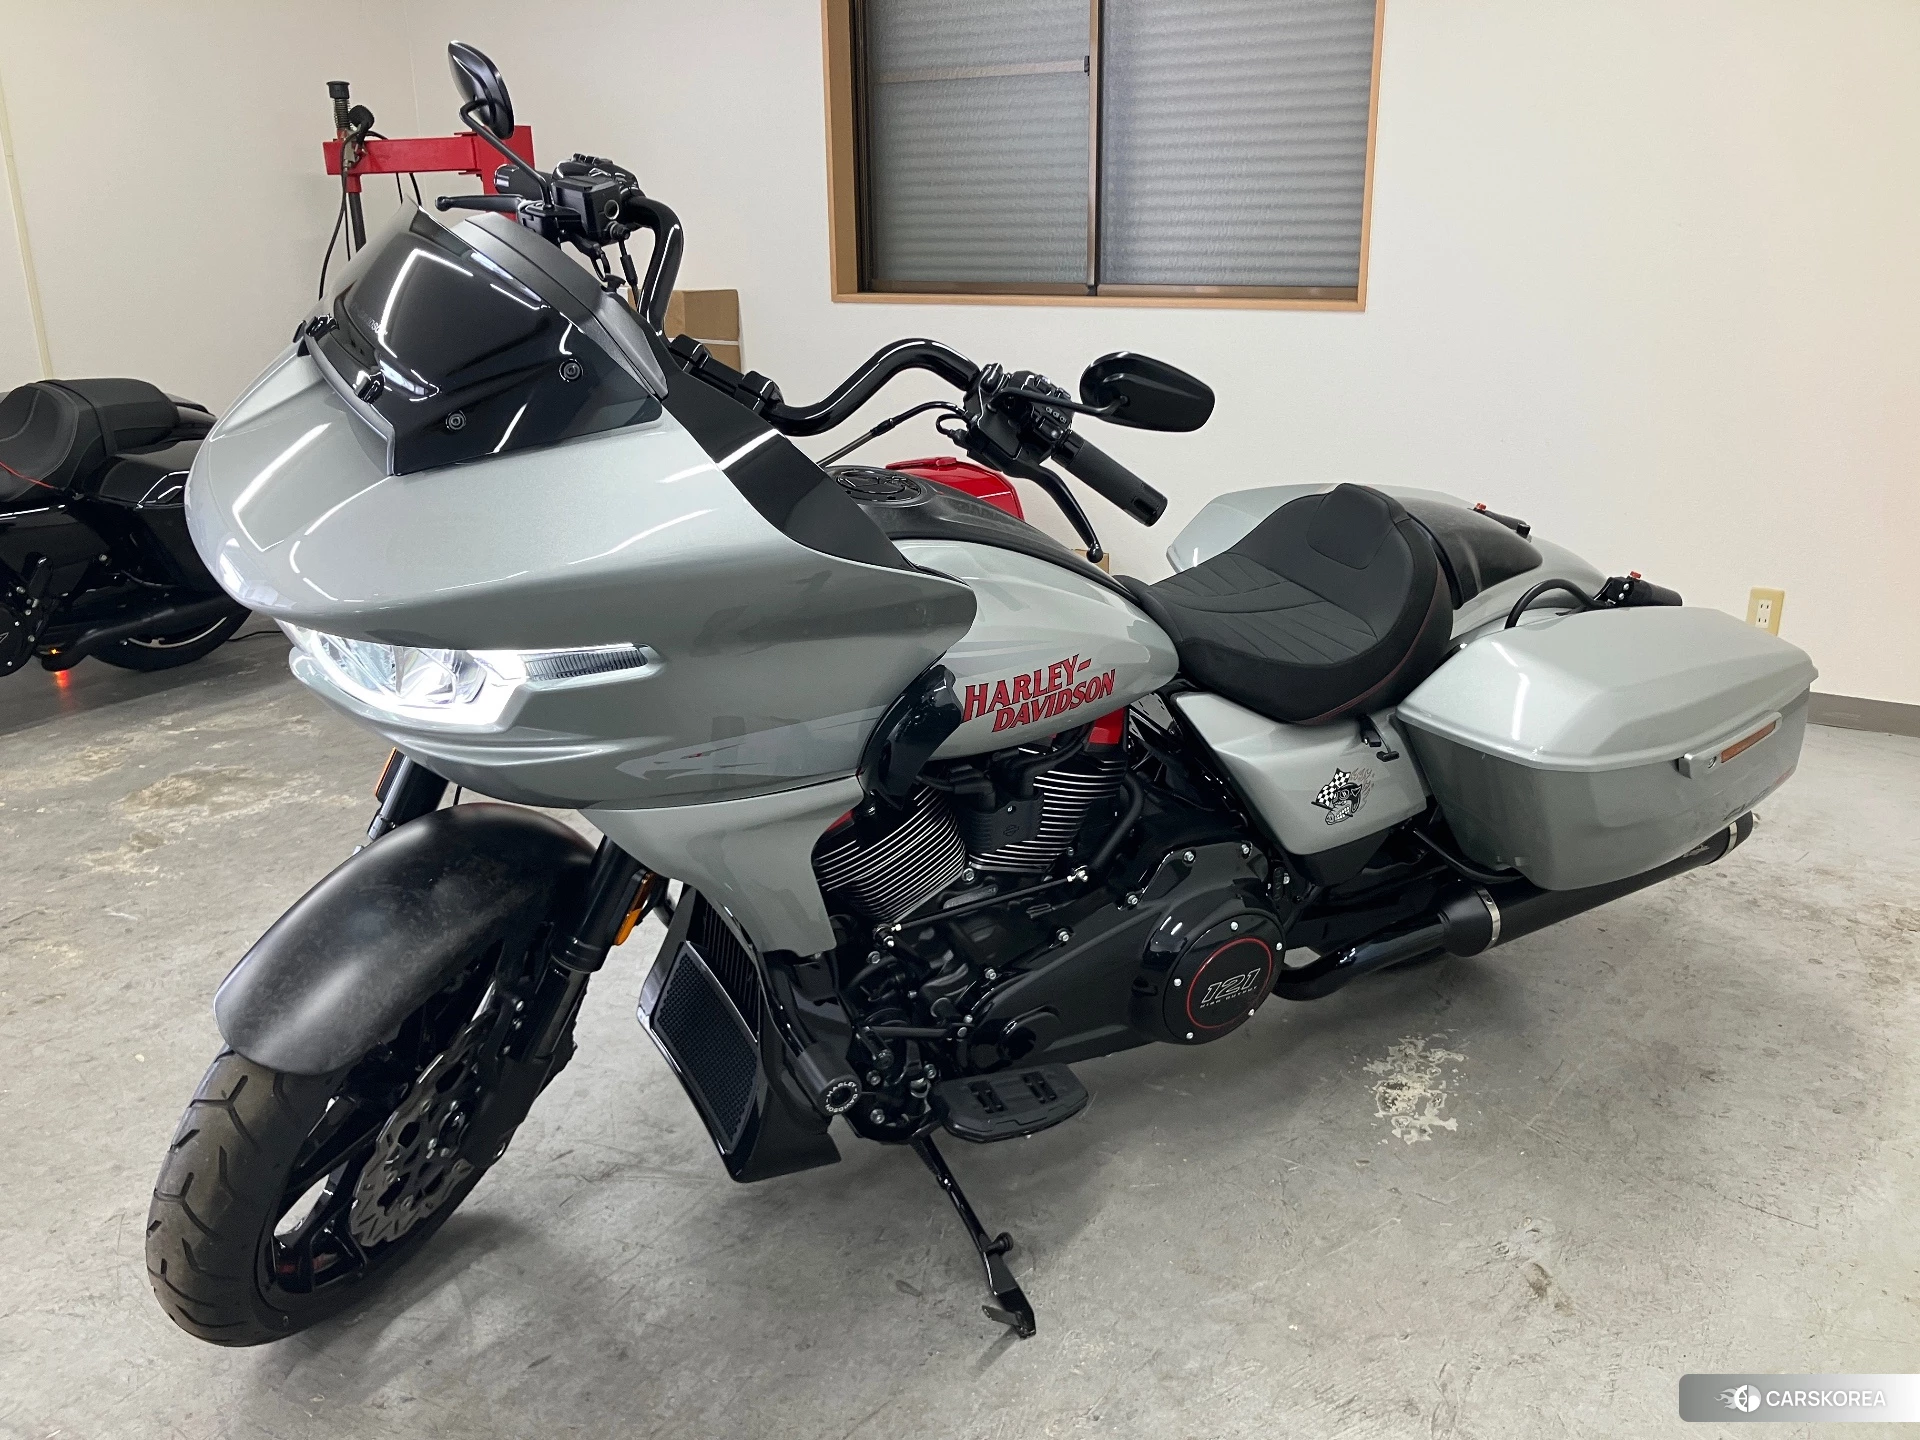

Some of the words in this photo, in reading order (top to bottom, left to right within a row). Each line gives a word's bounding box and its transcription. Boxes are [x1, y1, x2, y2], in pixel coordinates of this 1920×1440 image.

[961, 654, 1092, 723] HARLEY-
[992, 669, 1115, 733] DAVIDSON
[1201, 968, 1261, 1004] 121
